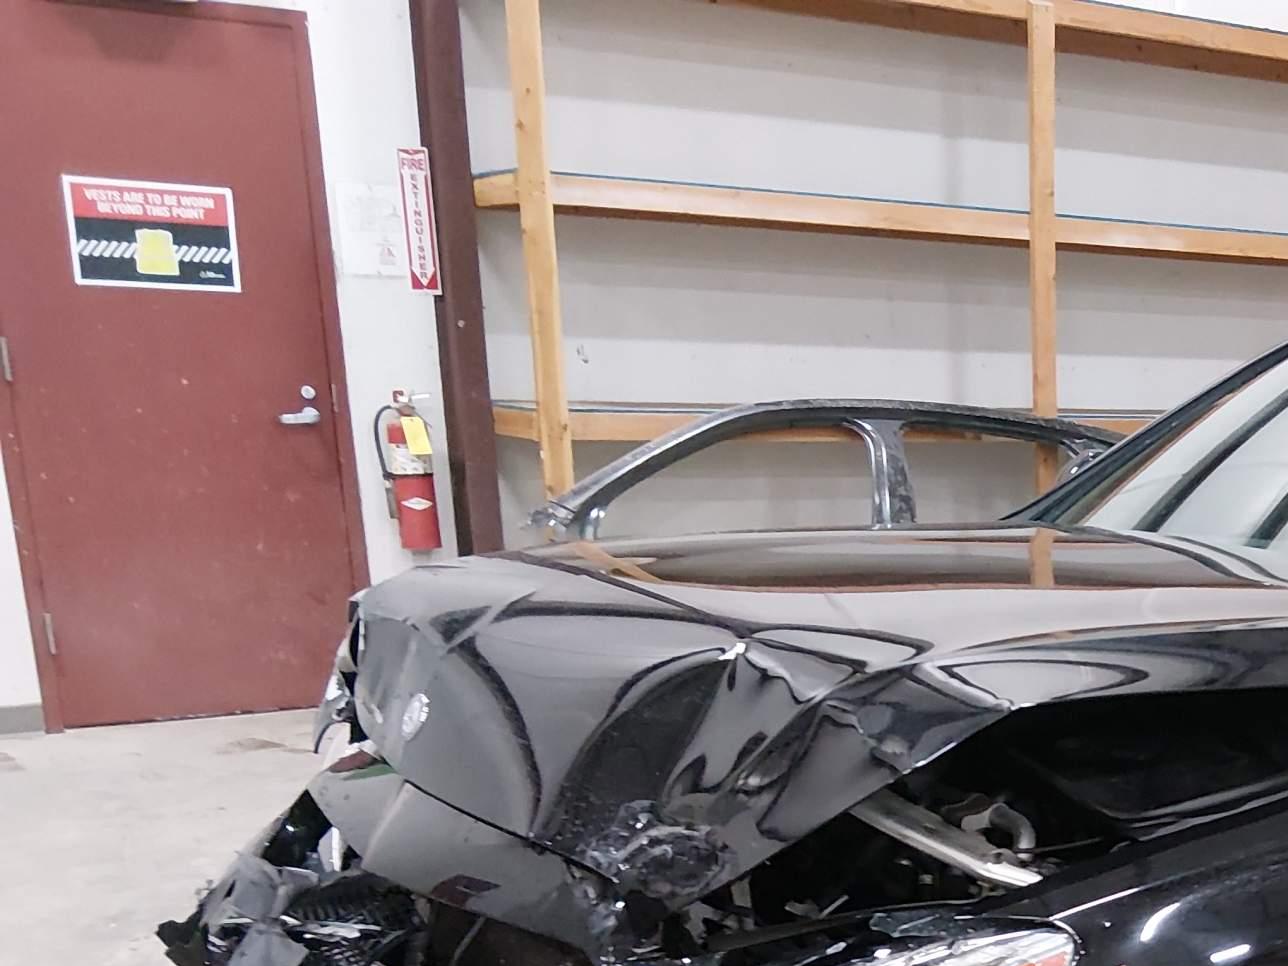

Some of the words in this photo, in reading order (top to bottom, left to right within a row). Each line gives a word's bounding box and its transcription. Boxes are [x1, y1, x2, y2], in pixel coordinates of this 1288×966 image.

[400, 157, 425, 171] FIRE
[83, 187, 120, 201] VESTS
[123, 191, 144, 202] ARE
[146, 192, 161, 204] TO
[163, 194, 179, 206] BE
[179, 195, 215, 209] WORN
[97, 202, 143, 215] BEYOND
[145, 204, 170, 217] THIS
[171, 207, 204, 219] POINT
[410, 173, 428, 279] EXTINGUISHER
